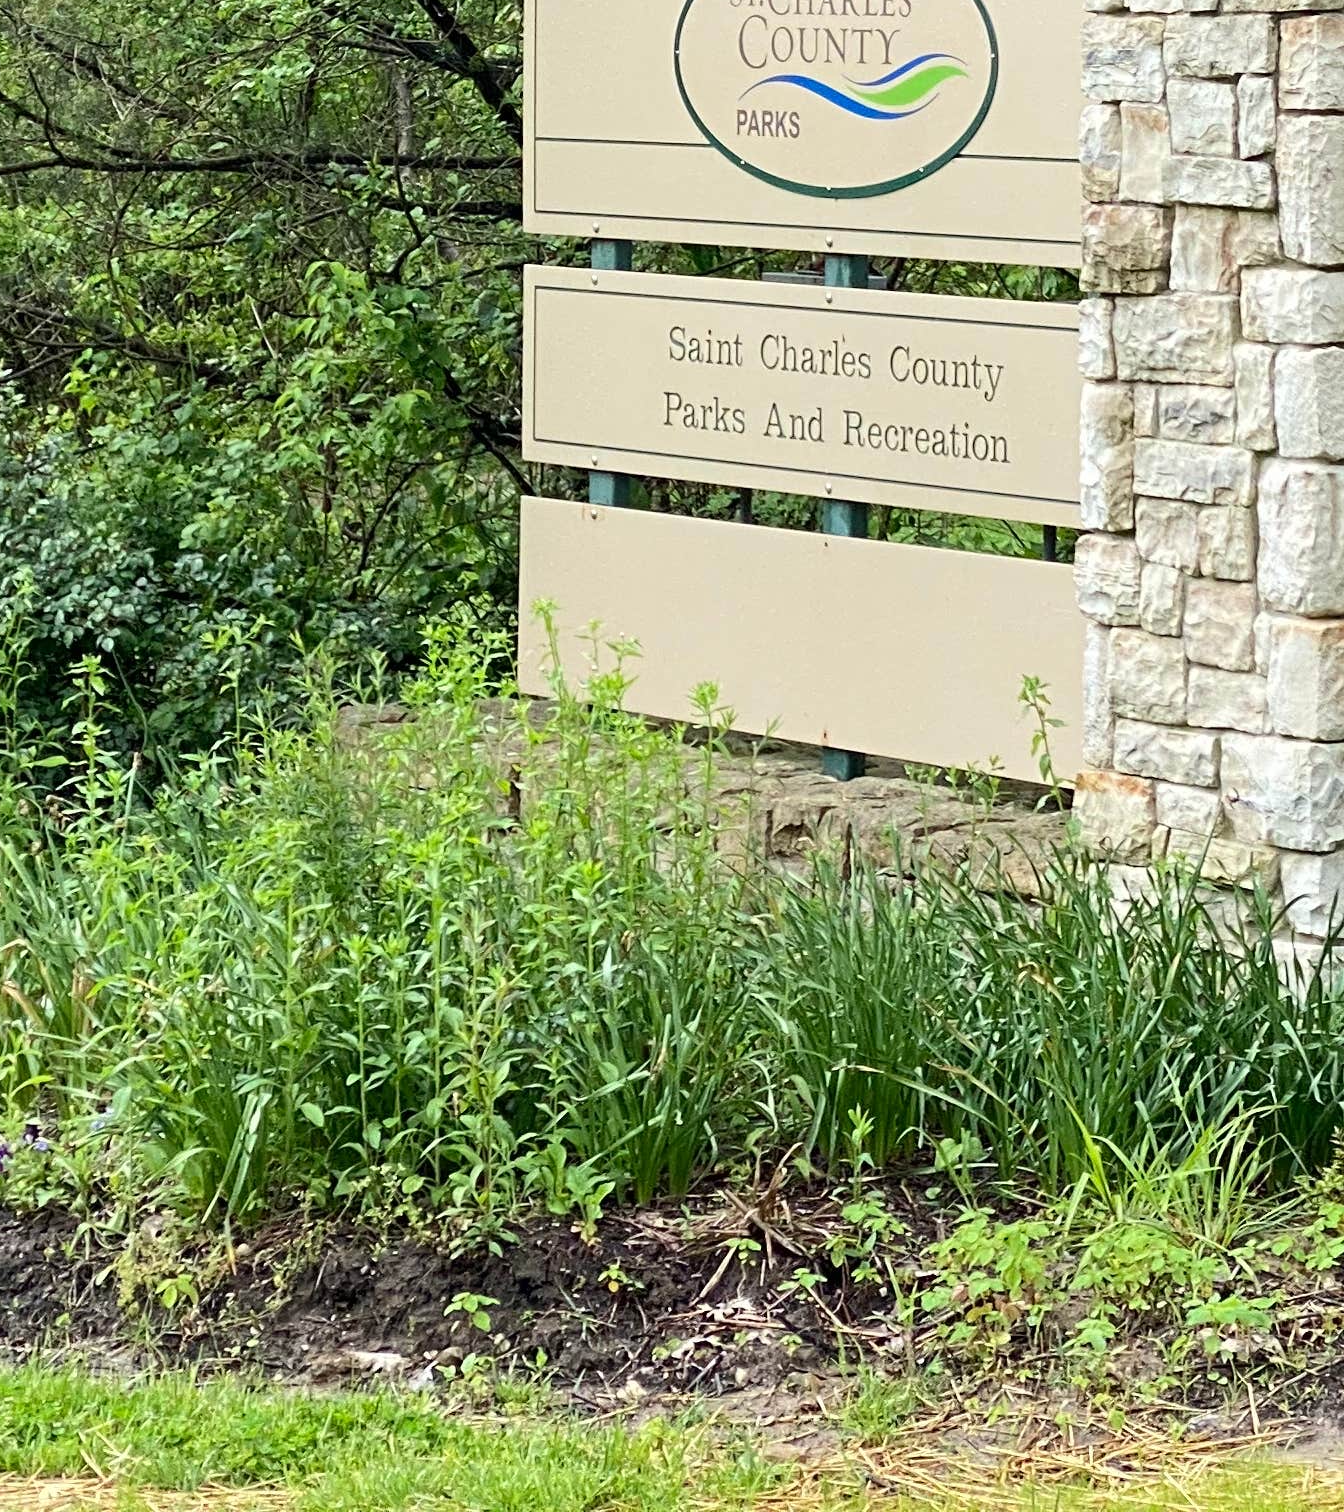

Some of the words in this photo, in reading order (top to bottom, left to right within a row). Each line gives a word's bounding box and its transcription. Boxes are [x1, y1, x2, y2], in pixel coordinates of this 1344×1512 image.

[738, 14, 901, 70] COUNTY
[736, 109, 801, 139] PARKS
[668, 325, 744, 367] Saint
[760, 333, 872, 380] Charles
[889, 345, 1005, 403] County
[663, 391, 746, 435] Parks
[762, 401, 825, 444] And
[842, 409, 1011, 464] Recreation
